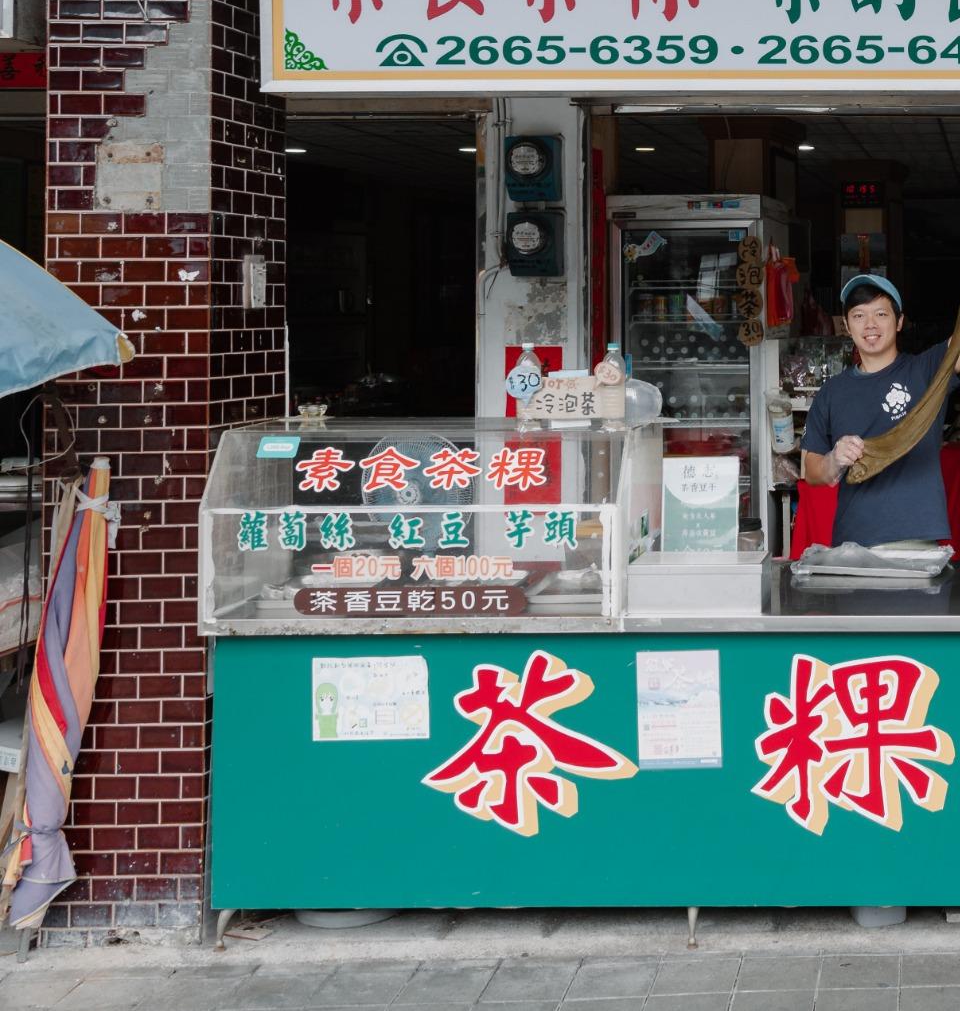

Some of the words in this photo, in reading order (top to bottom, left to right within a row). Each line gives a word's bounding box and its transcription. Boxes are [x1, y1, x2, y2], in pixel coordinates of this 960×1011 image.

[435, 34, 720, 66] 2665-6359
[517, 372, 541, 392] 30
[536, 391, 596, 416] 冷泡茶
[295, 446, 547, 492] 素食茶粿
[388, 512, 471, 549] 紅豆
[504, 509, 579, 550] 芋頭
[311, 556, 402, 581] 一個20元
[410, 555, 514, 581] 六個100元
[309, 590, 510, 613] 茶香豆乾50元
[421, 649, 956, 837] 茶粿
